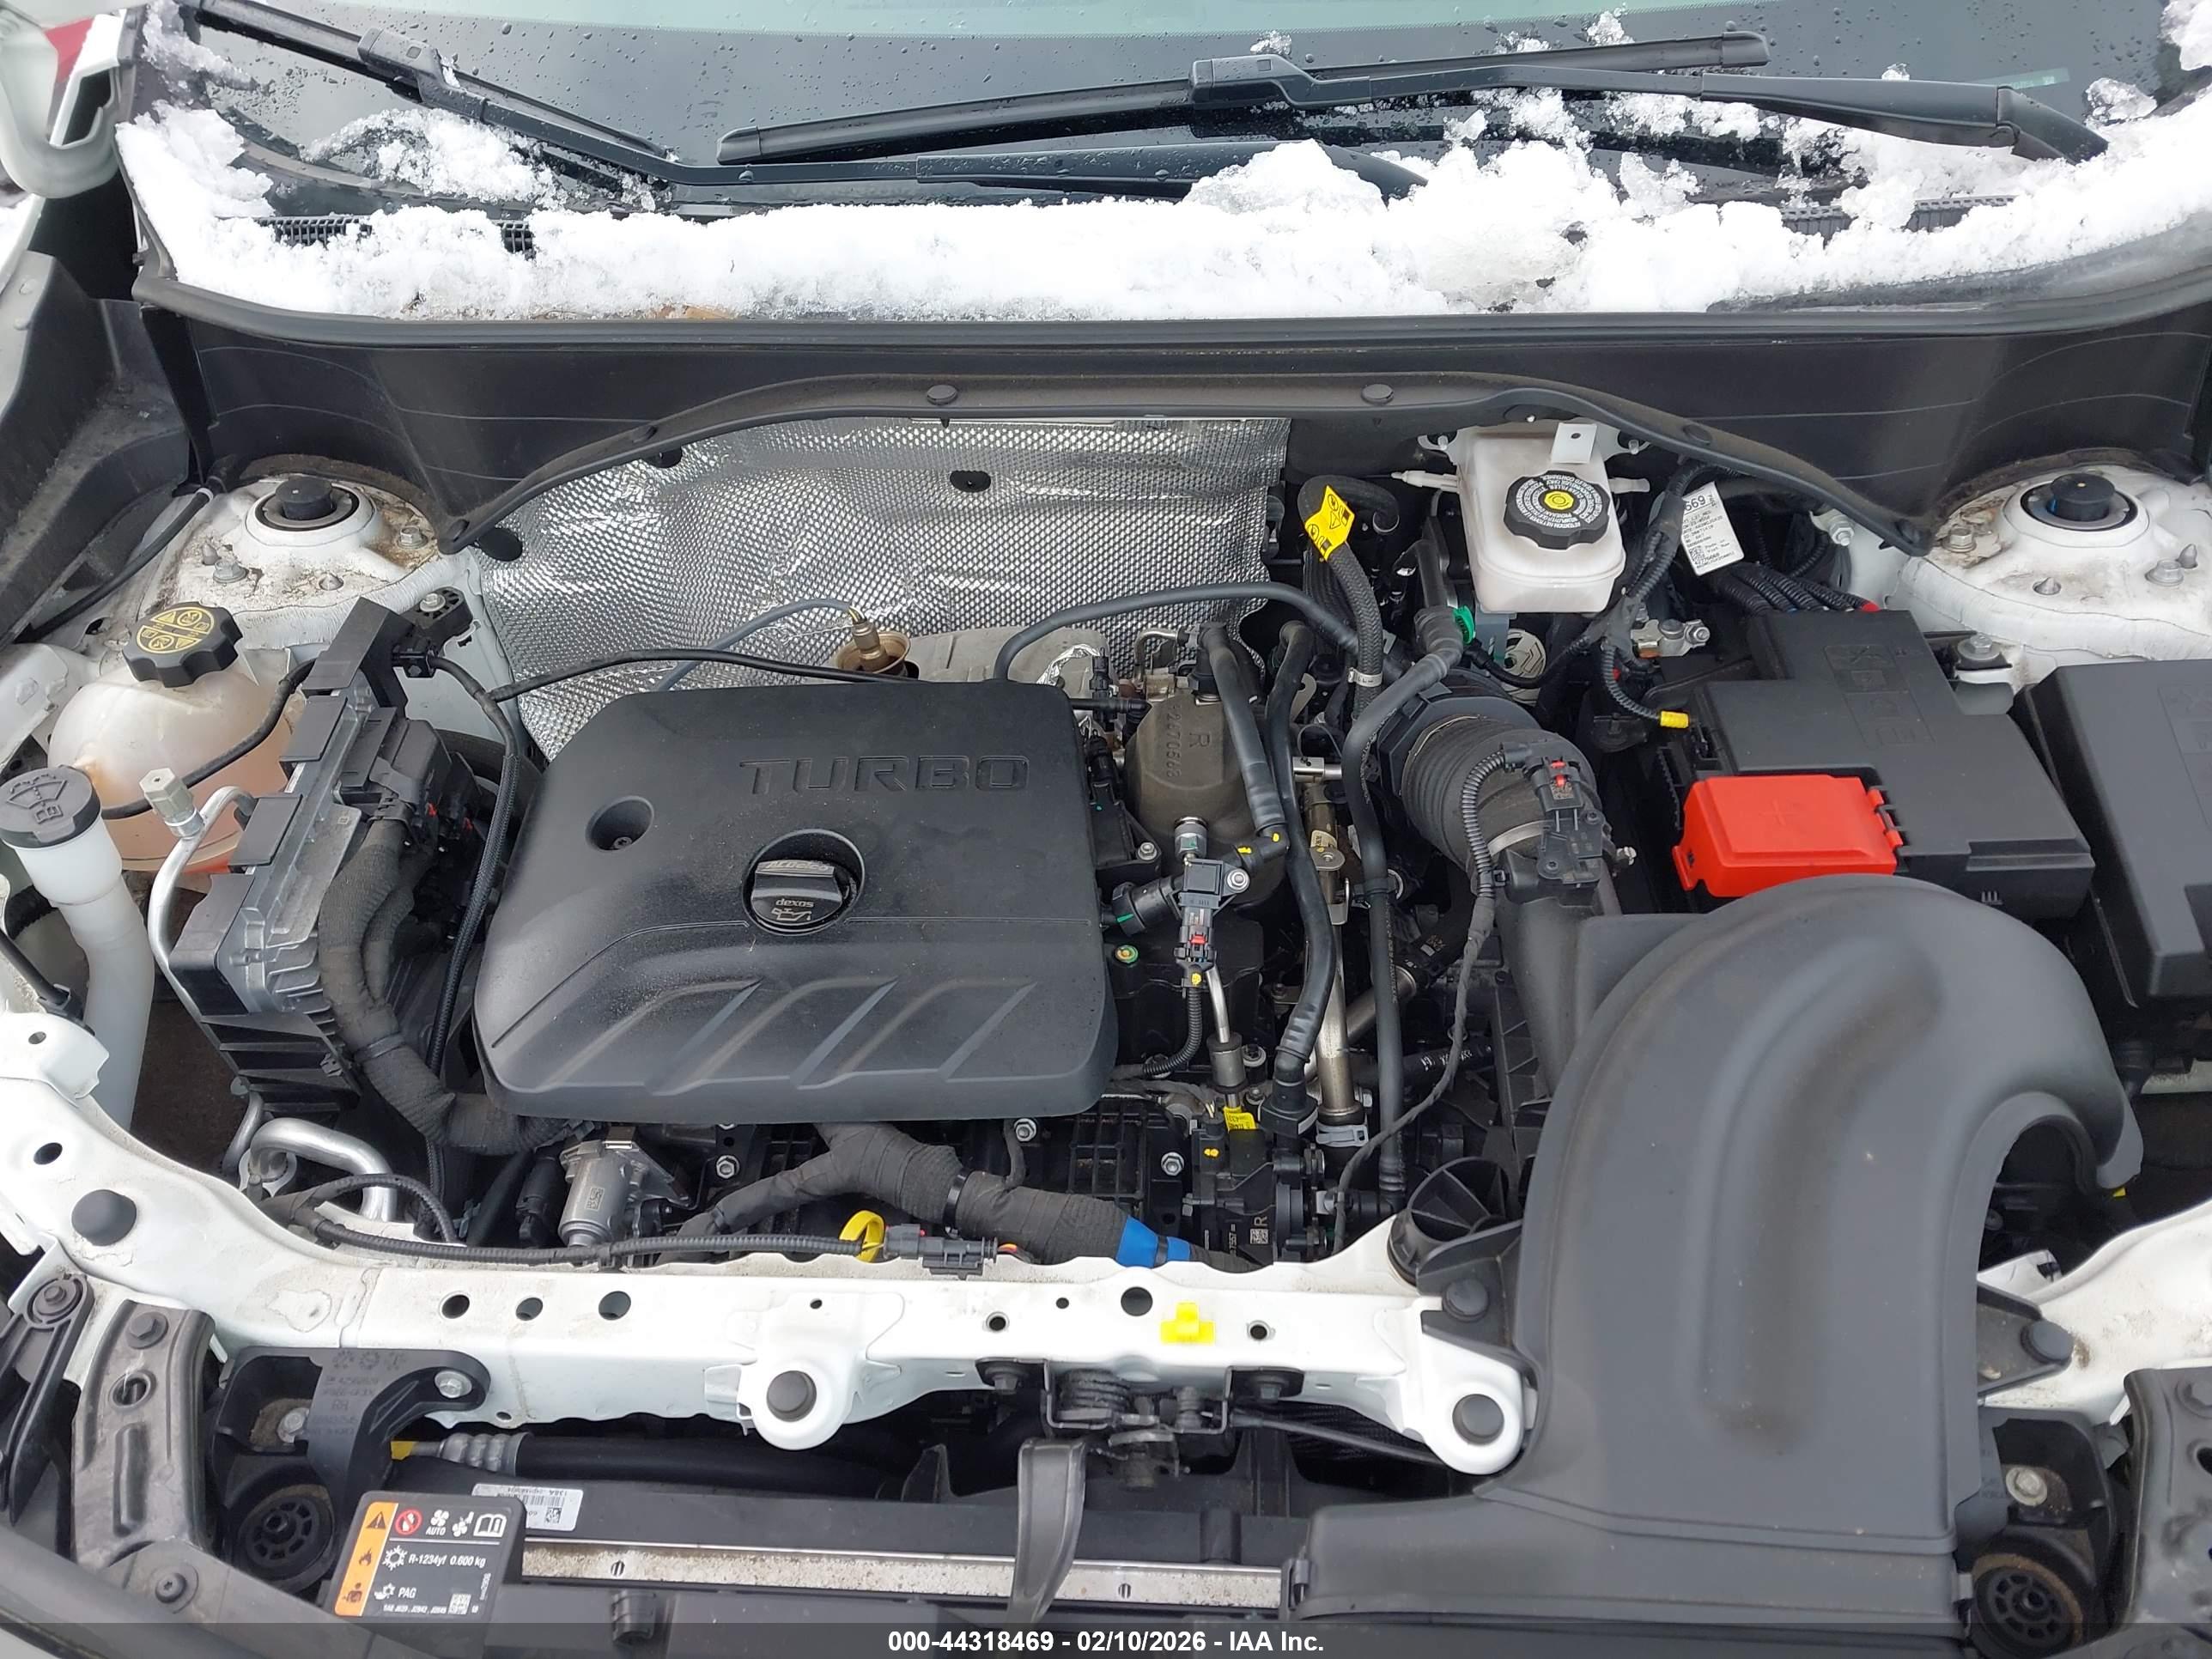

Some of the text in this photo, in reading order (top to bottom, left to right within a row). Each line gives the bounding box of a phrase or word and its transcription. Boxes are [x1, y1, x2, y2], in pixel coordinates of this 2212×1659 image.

[1188, 731, 1212, 748] R
[738, 755, 1030, 795] TURBO
[775, 898, 814, 908] dexos
[1254, 1216, 1267, 1226] R
[425, 1526, 447, 1536] AUTO
[408, 1553, 487, 1569] R-1234yf 0.600 kg
[398, 1586, 416, 1599] PAG
